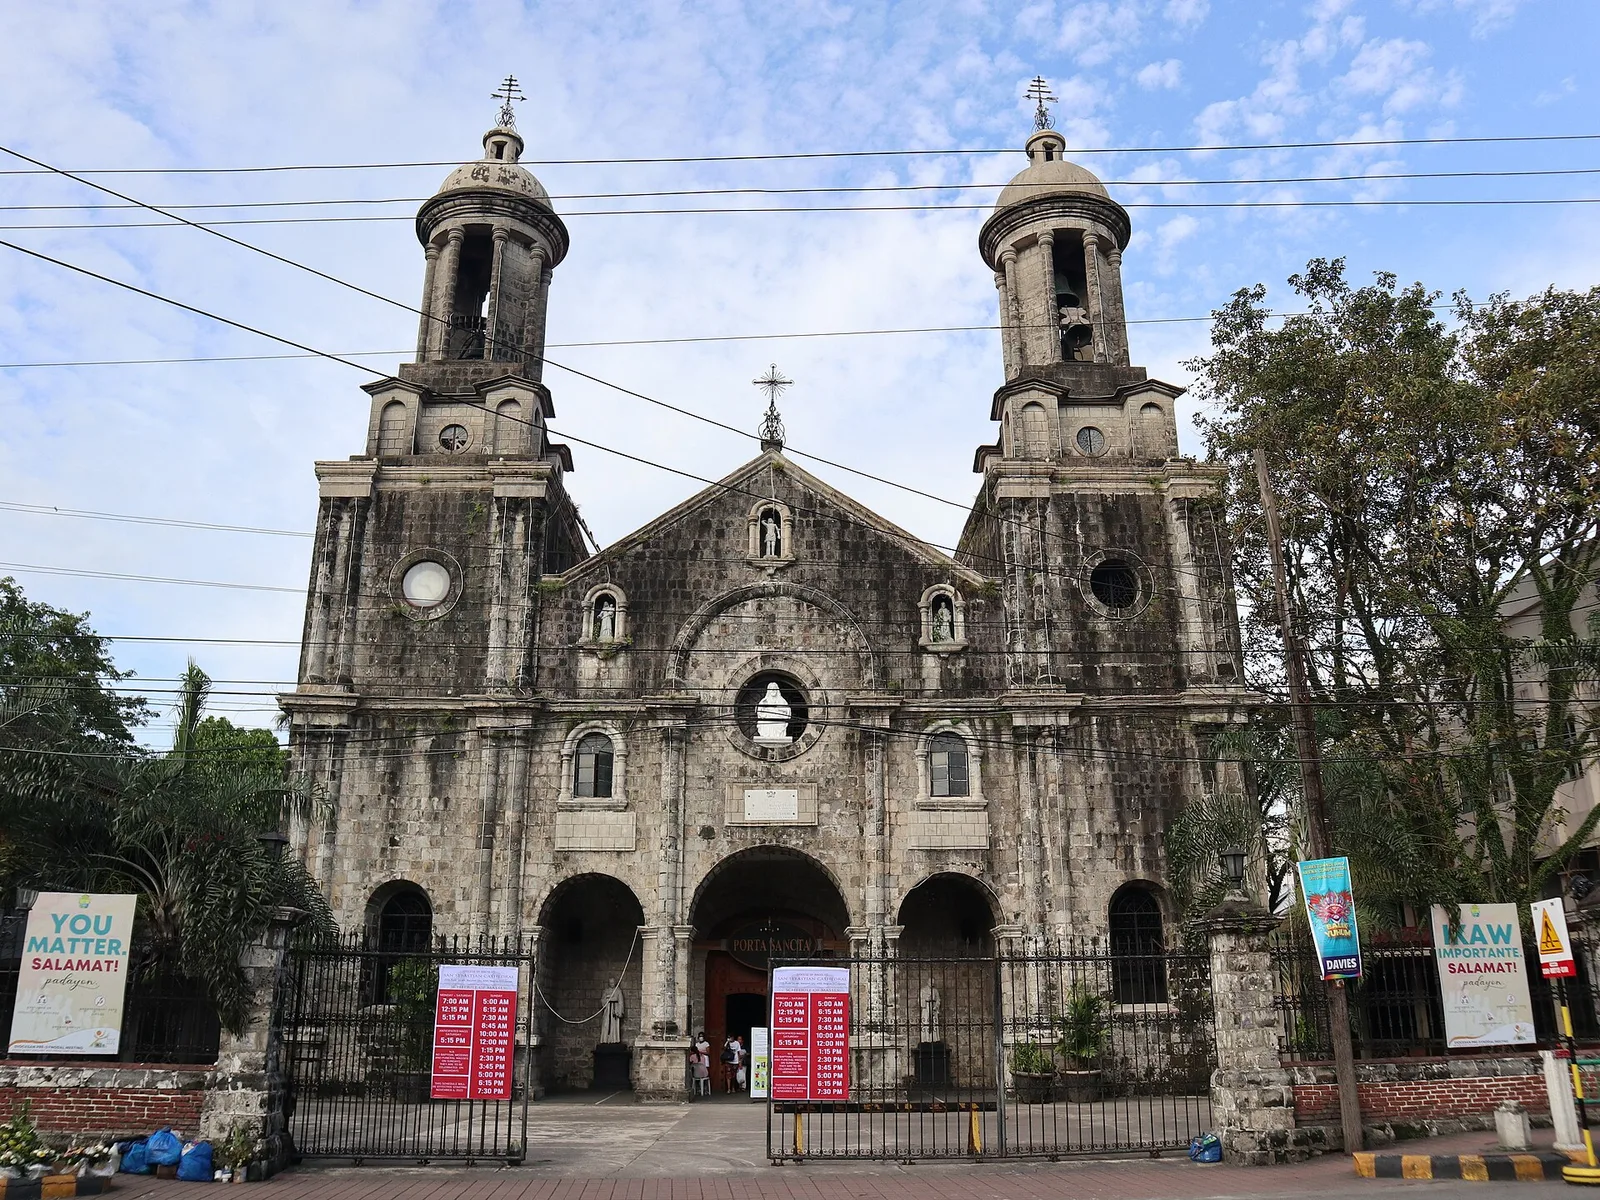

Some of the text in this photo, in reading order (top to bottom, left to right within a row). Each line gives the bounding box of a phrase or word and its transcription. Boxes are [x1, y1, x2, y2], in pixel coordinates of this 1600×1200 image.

[51, 913, 113, 935] YOU
[26, 936, 127, 955] MATTER.
[733, 939, 811, 952] PORTA SANCTA
[1439, 947, 1523, 959] IMPORTANTE.
[31, 958, 119, 972] SALAMAT!
[1326, 958, 1357, 970] DAVIES
[1448, 962, 1517, 974] SALAMAT!
